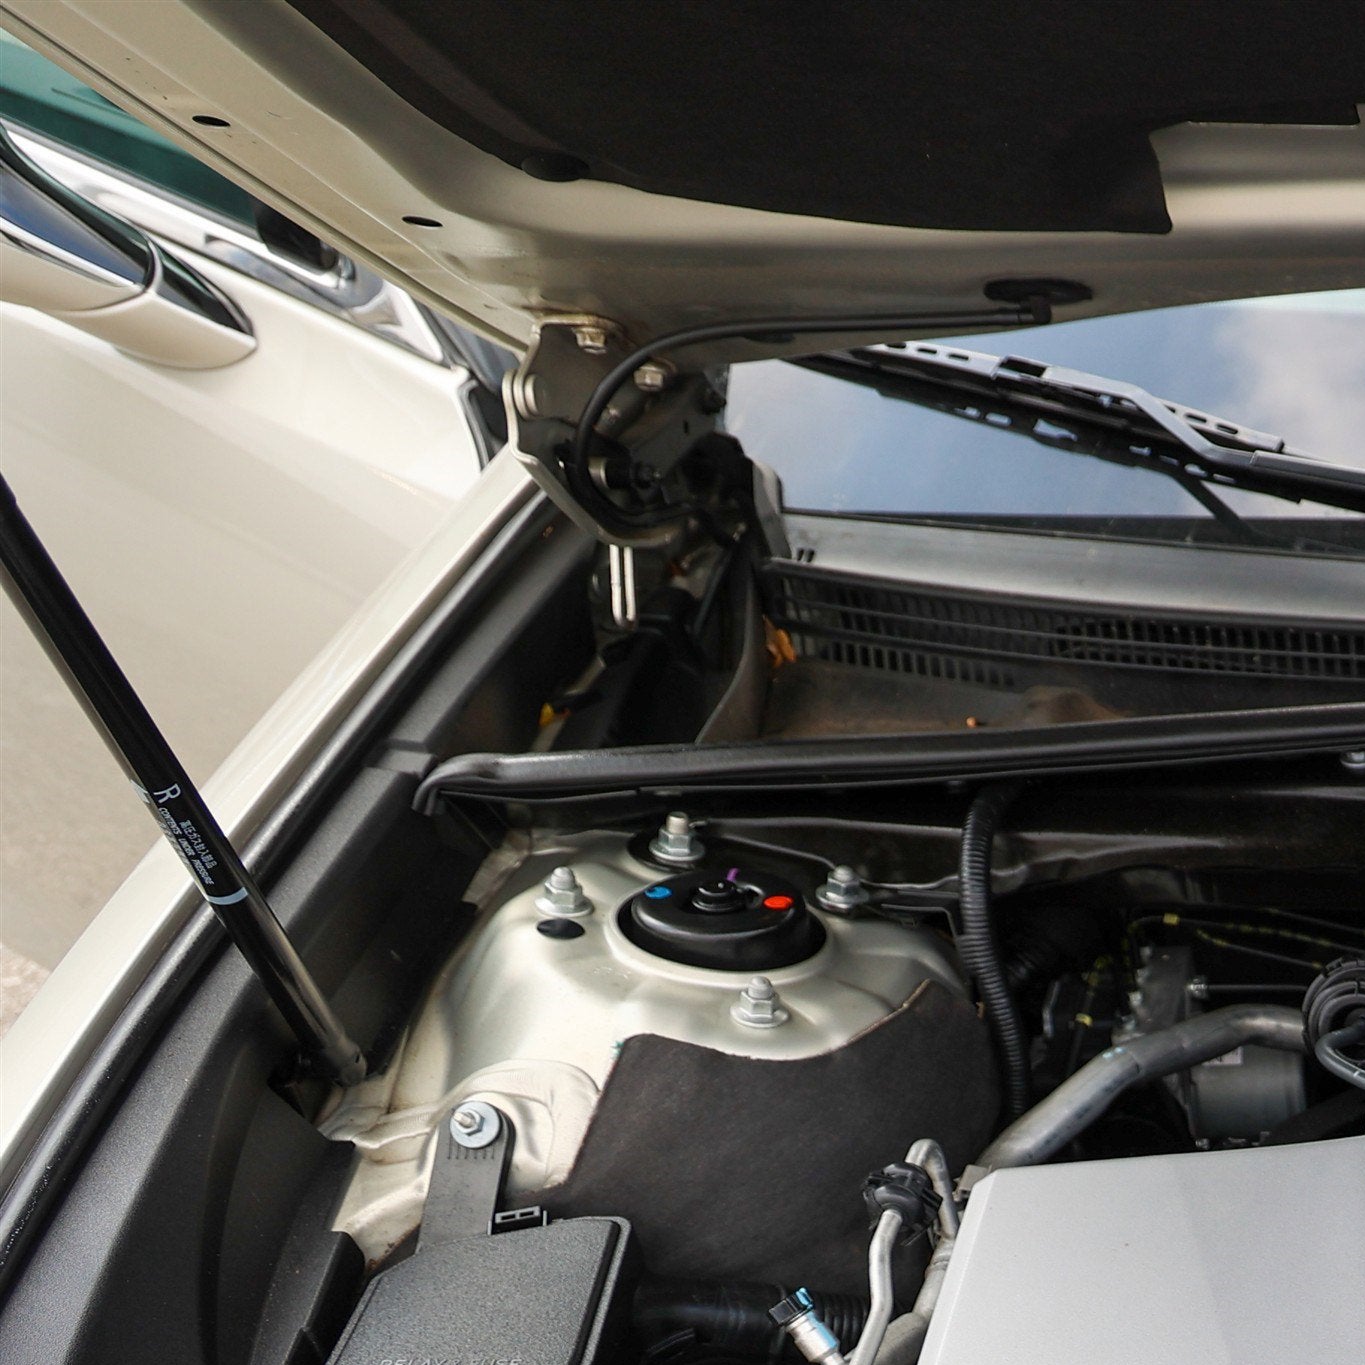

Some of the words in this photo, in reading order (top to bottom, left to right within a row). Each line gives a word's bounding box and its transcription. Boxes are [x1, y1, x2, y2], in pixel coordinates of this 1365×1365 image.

[153, 783, 181, 804] R
[159, 807, 181, 835] CONTENTS
[179, 837, 196, 858] UNDER
[194, 859, 215, 886] PRESSURE
